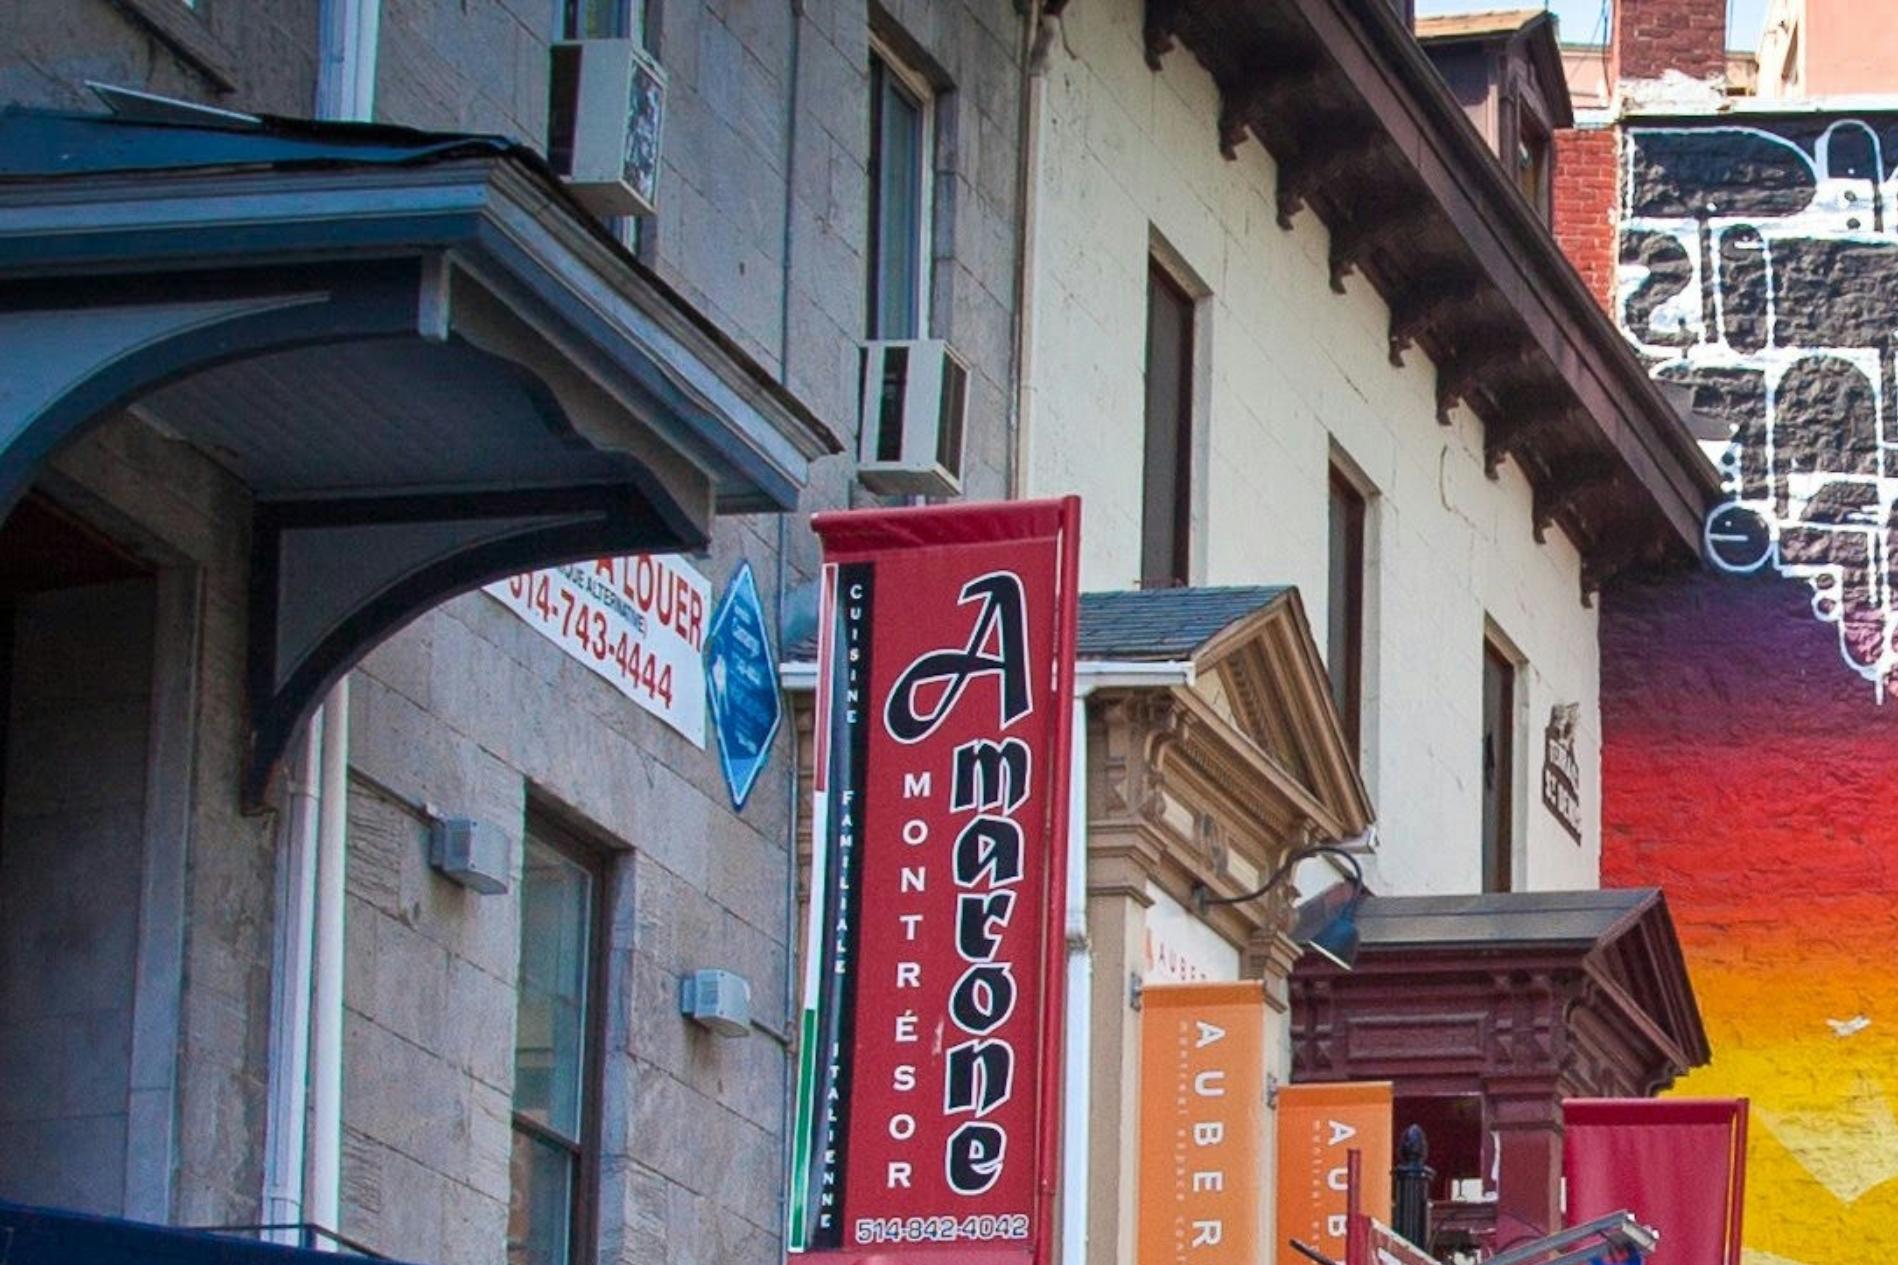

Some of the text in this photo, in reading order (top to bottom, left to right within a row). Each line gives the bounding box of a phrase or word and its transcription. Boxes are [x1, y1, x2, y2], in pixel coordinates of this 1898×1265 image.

[623, 554, 702, 653] LOUER
[820, 583, 863, 1228] CUISINE FAMILIALE ITALIENNE
[884, 570, 1033, 1195] Amarone
[856, 1213, 1029, 1244] 514-842-4042
